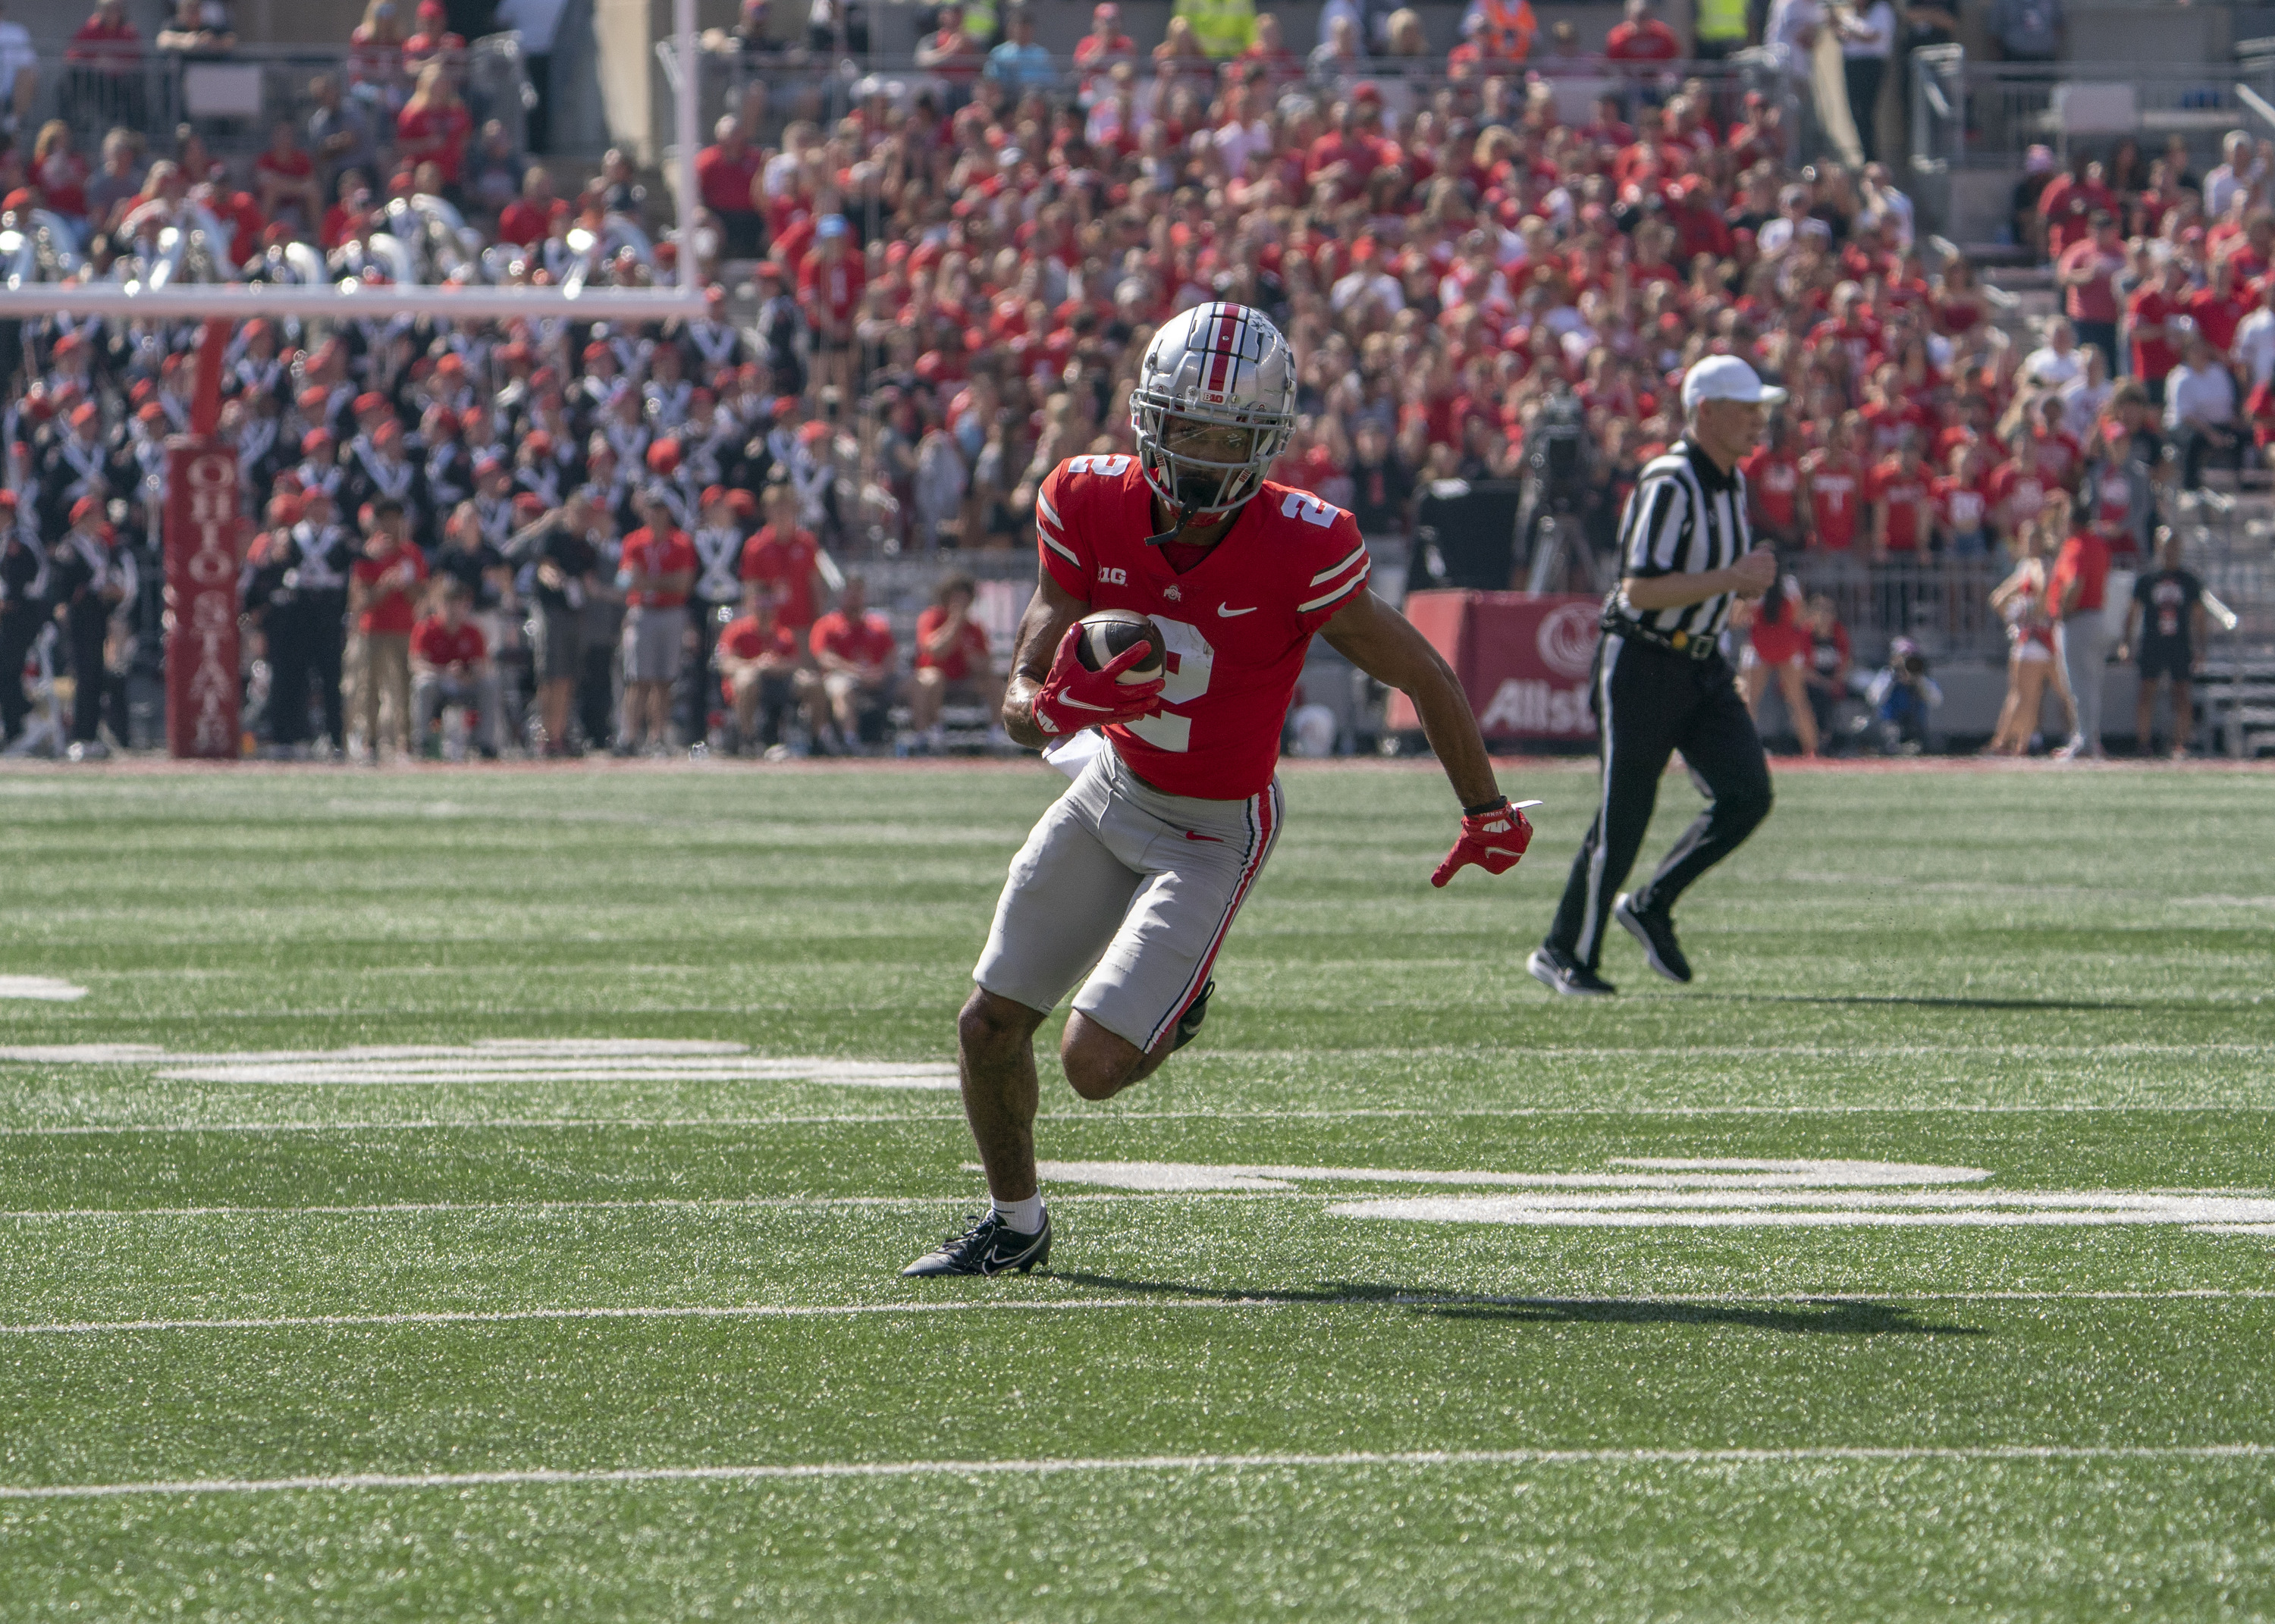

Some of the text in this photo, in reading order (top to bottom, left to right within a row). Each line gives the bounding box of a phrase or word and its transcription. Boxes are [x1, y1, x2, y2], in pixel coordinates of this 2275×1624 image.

[1068, 455, 1131, 476] 2
[187, 456, 234, 584] OHIO
[1280, 492, 1340, 528] 2
